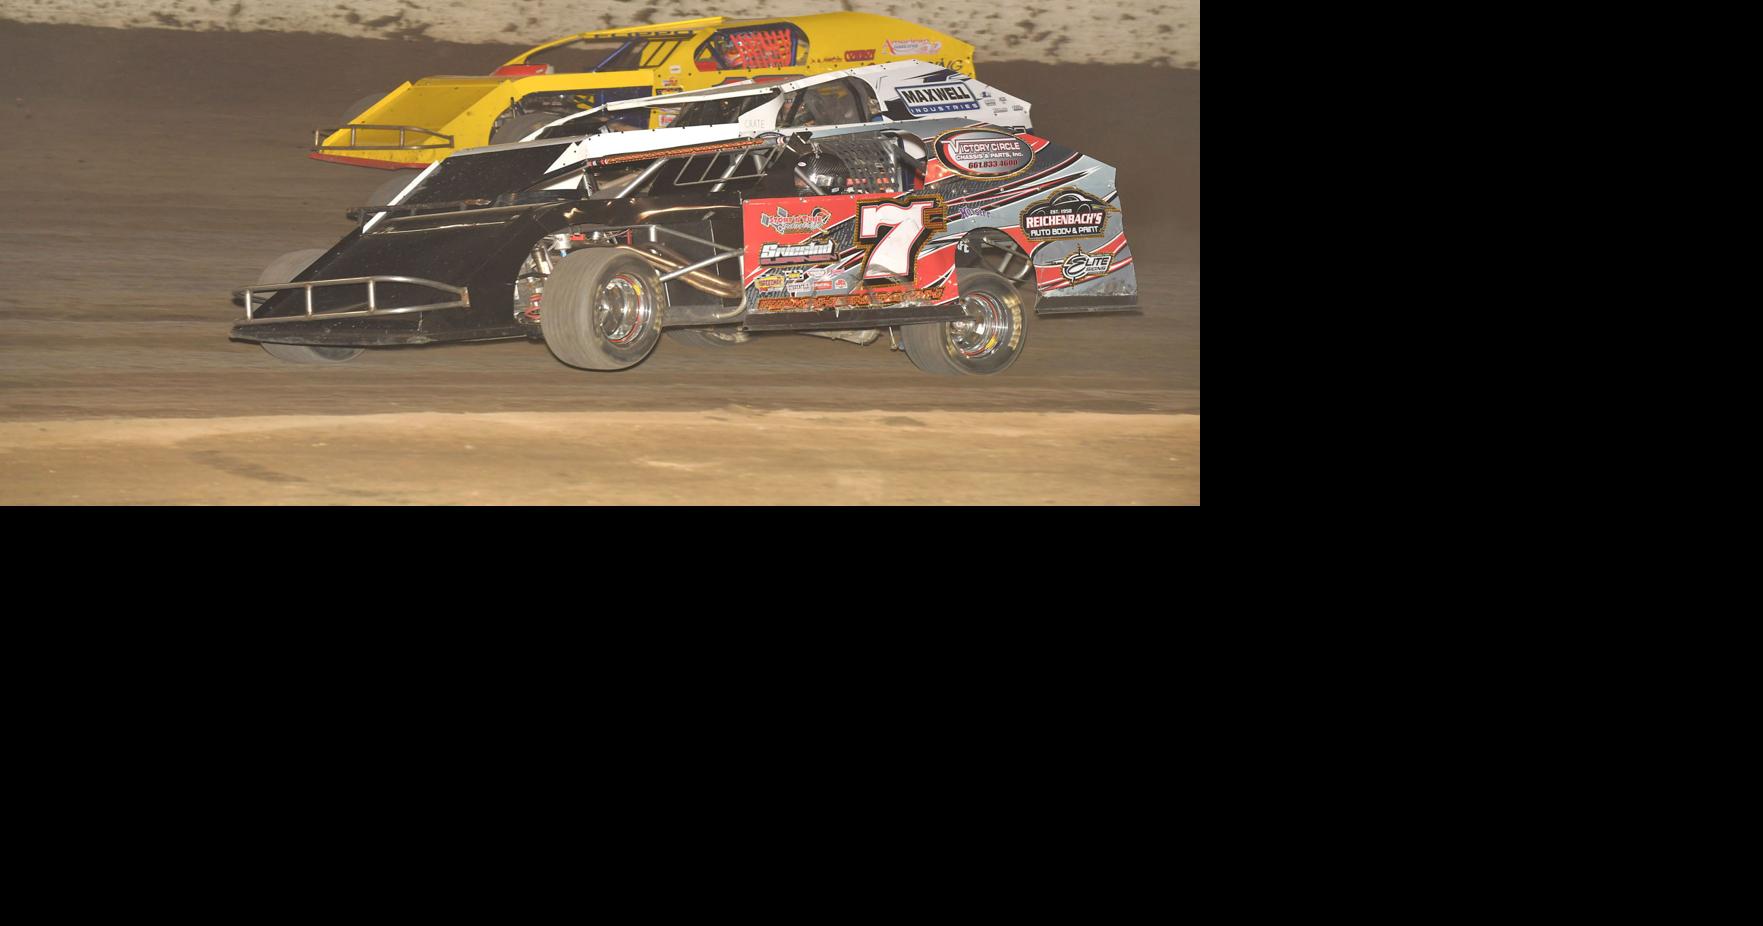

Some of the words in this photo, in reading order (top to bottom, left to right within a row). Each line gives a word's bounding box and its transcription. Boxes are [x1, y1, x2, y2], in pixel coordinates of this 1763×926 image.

[901, 86, 971, 104] MAXWELL
[910, 102, 979, 113] INDUSTRIES
[948, 139, 990, 154] VICTORY
[990, 142, 1021, 152] CIRCLE
[1026, 212, 1103, 229] REICHENBACH'S
[1030, 229, 1051, 237] AUTO
[1078, 225, 1099, 234] PAINT
[1064, 256, 1110, 275] ELITE
